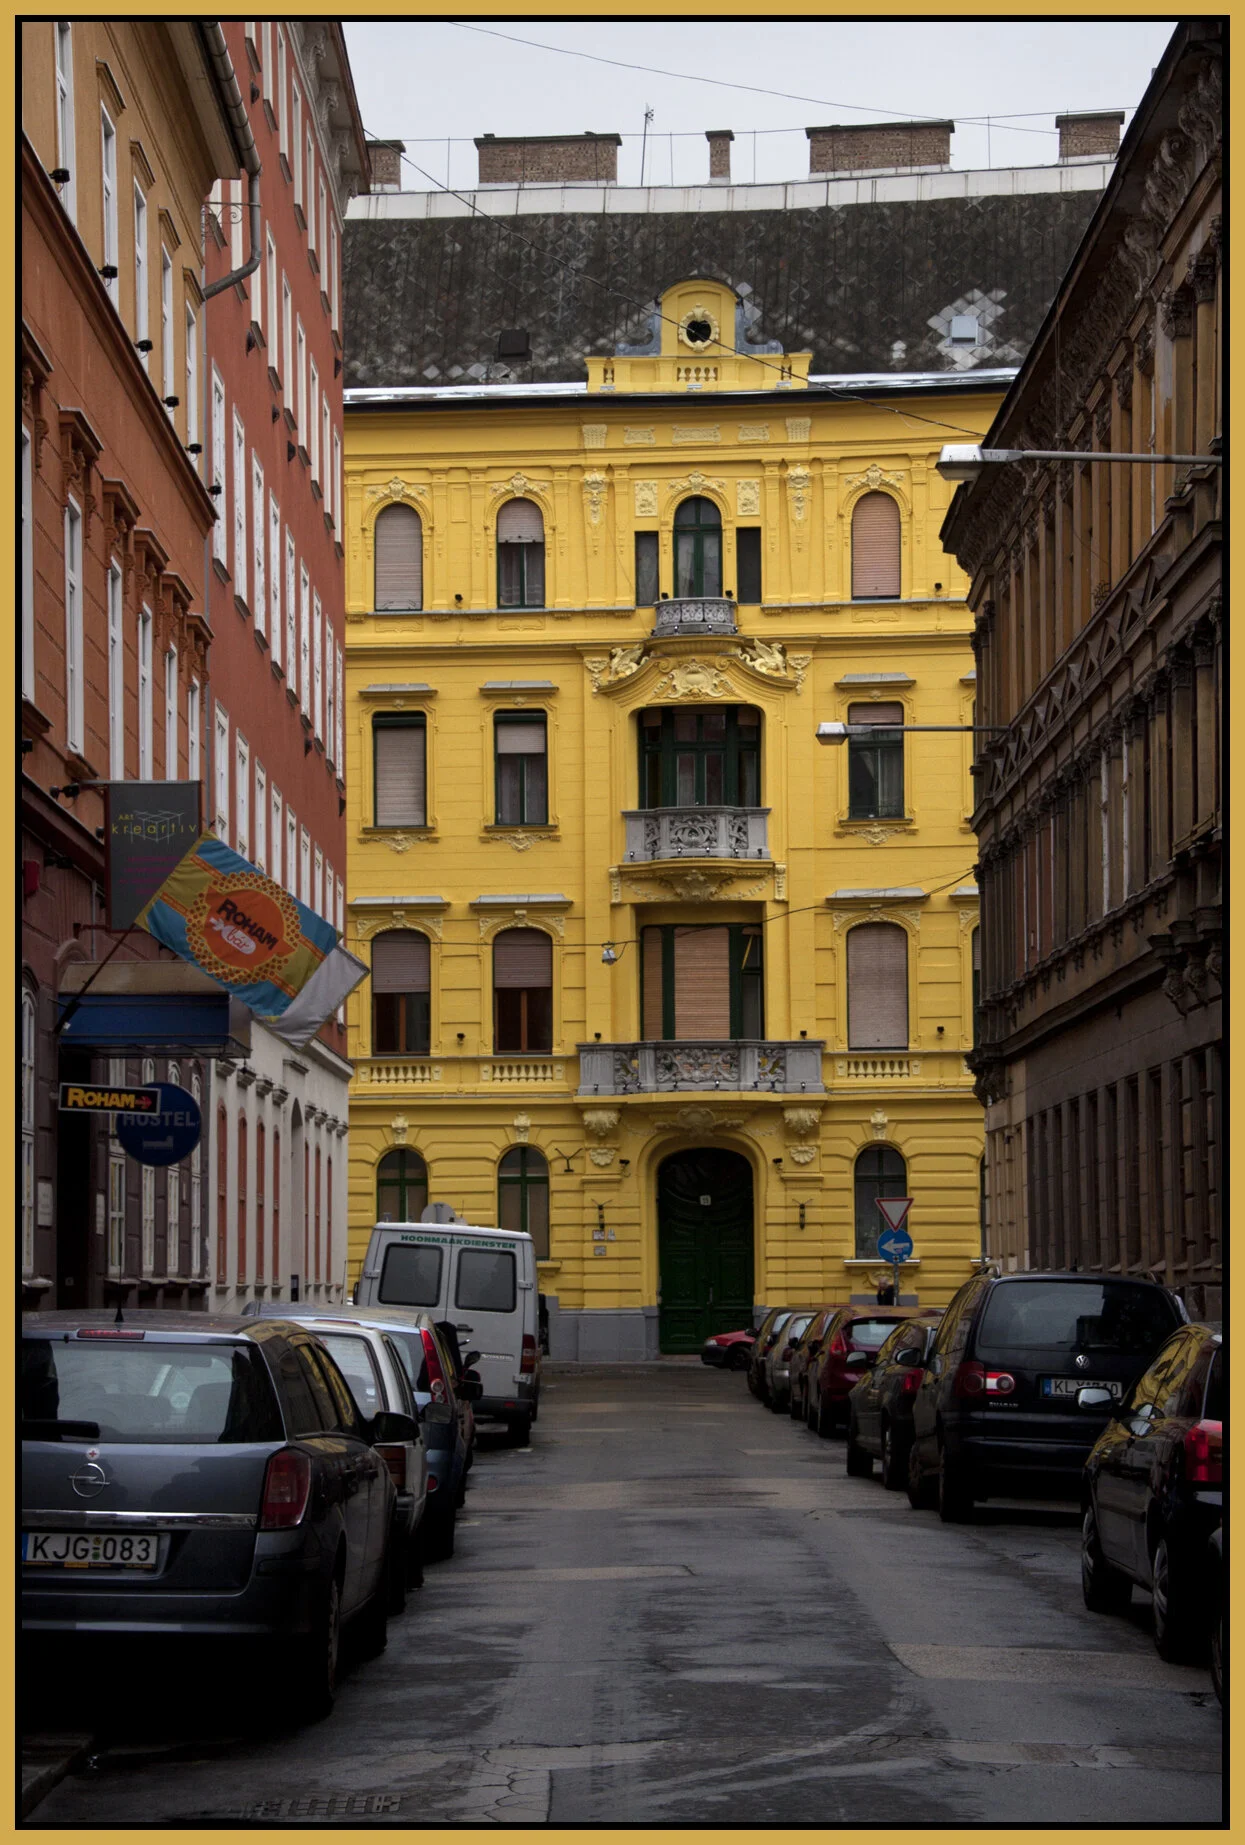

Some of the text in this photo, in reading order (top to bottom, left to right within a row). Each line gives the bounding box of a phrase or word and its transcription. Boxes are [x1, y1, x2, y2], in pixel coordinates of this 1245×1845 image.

[216, 898, 279, 951] ROHAM
[227, 927, 249, 949] bár
[67, 1087, 136, 1109] ROHAM
[122, 1111, 196, 1127] HOSTEL
[401, 1234, 516, 1249] HOONMAAKDIENSTEN
